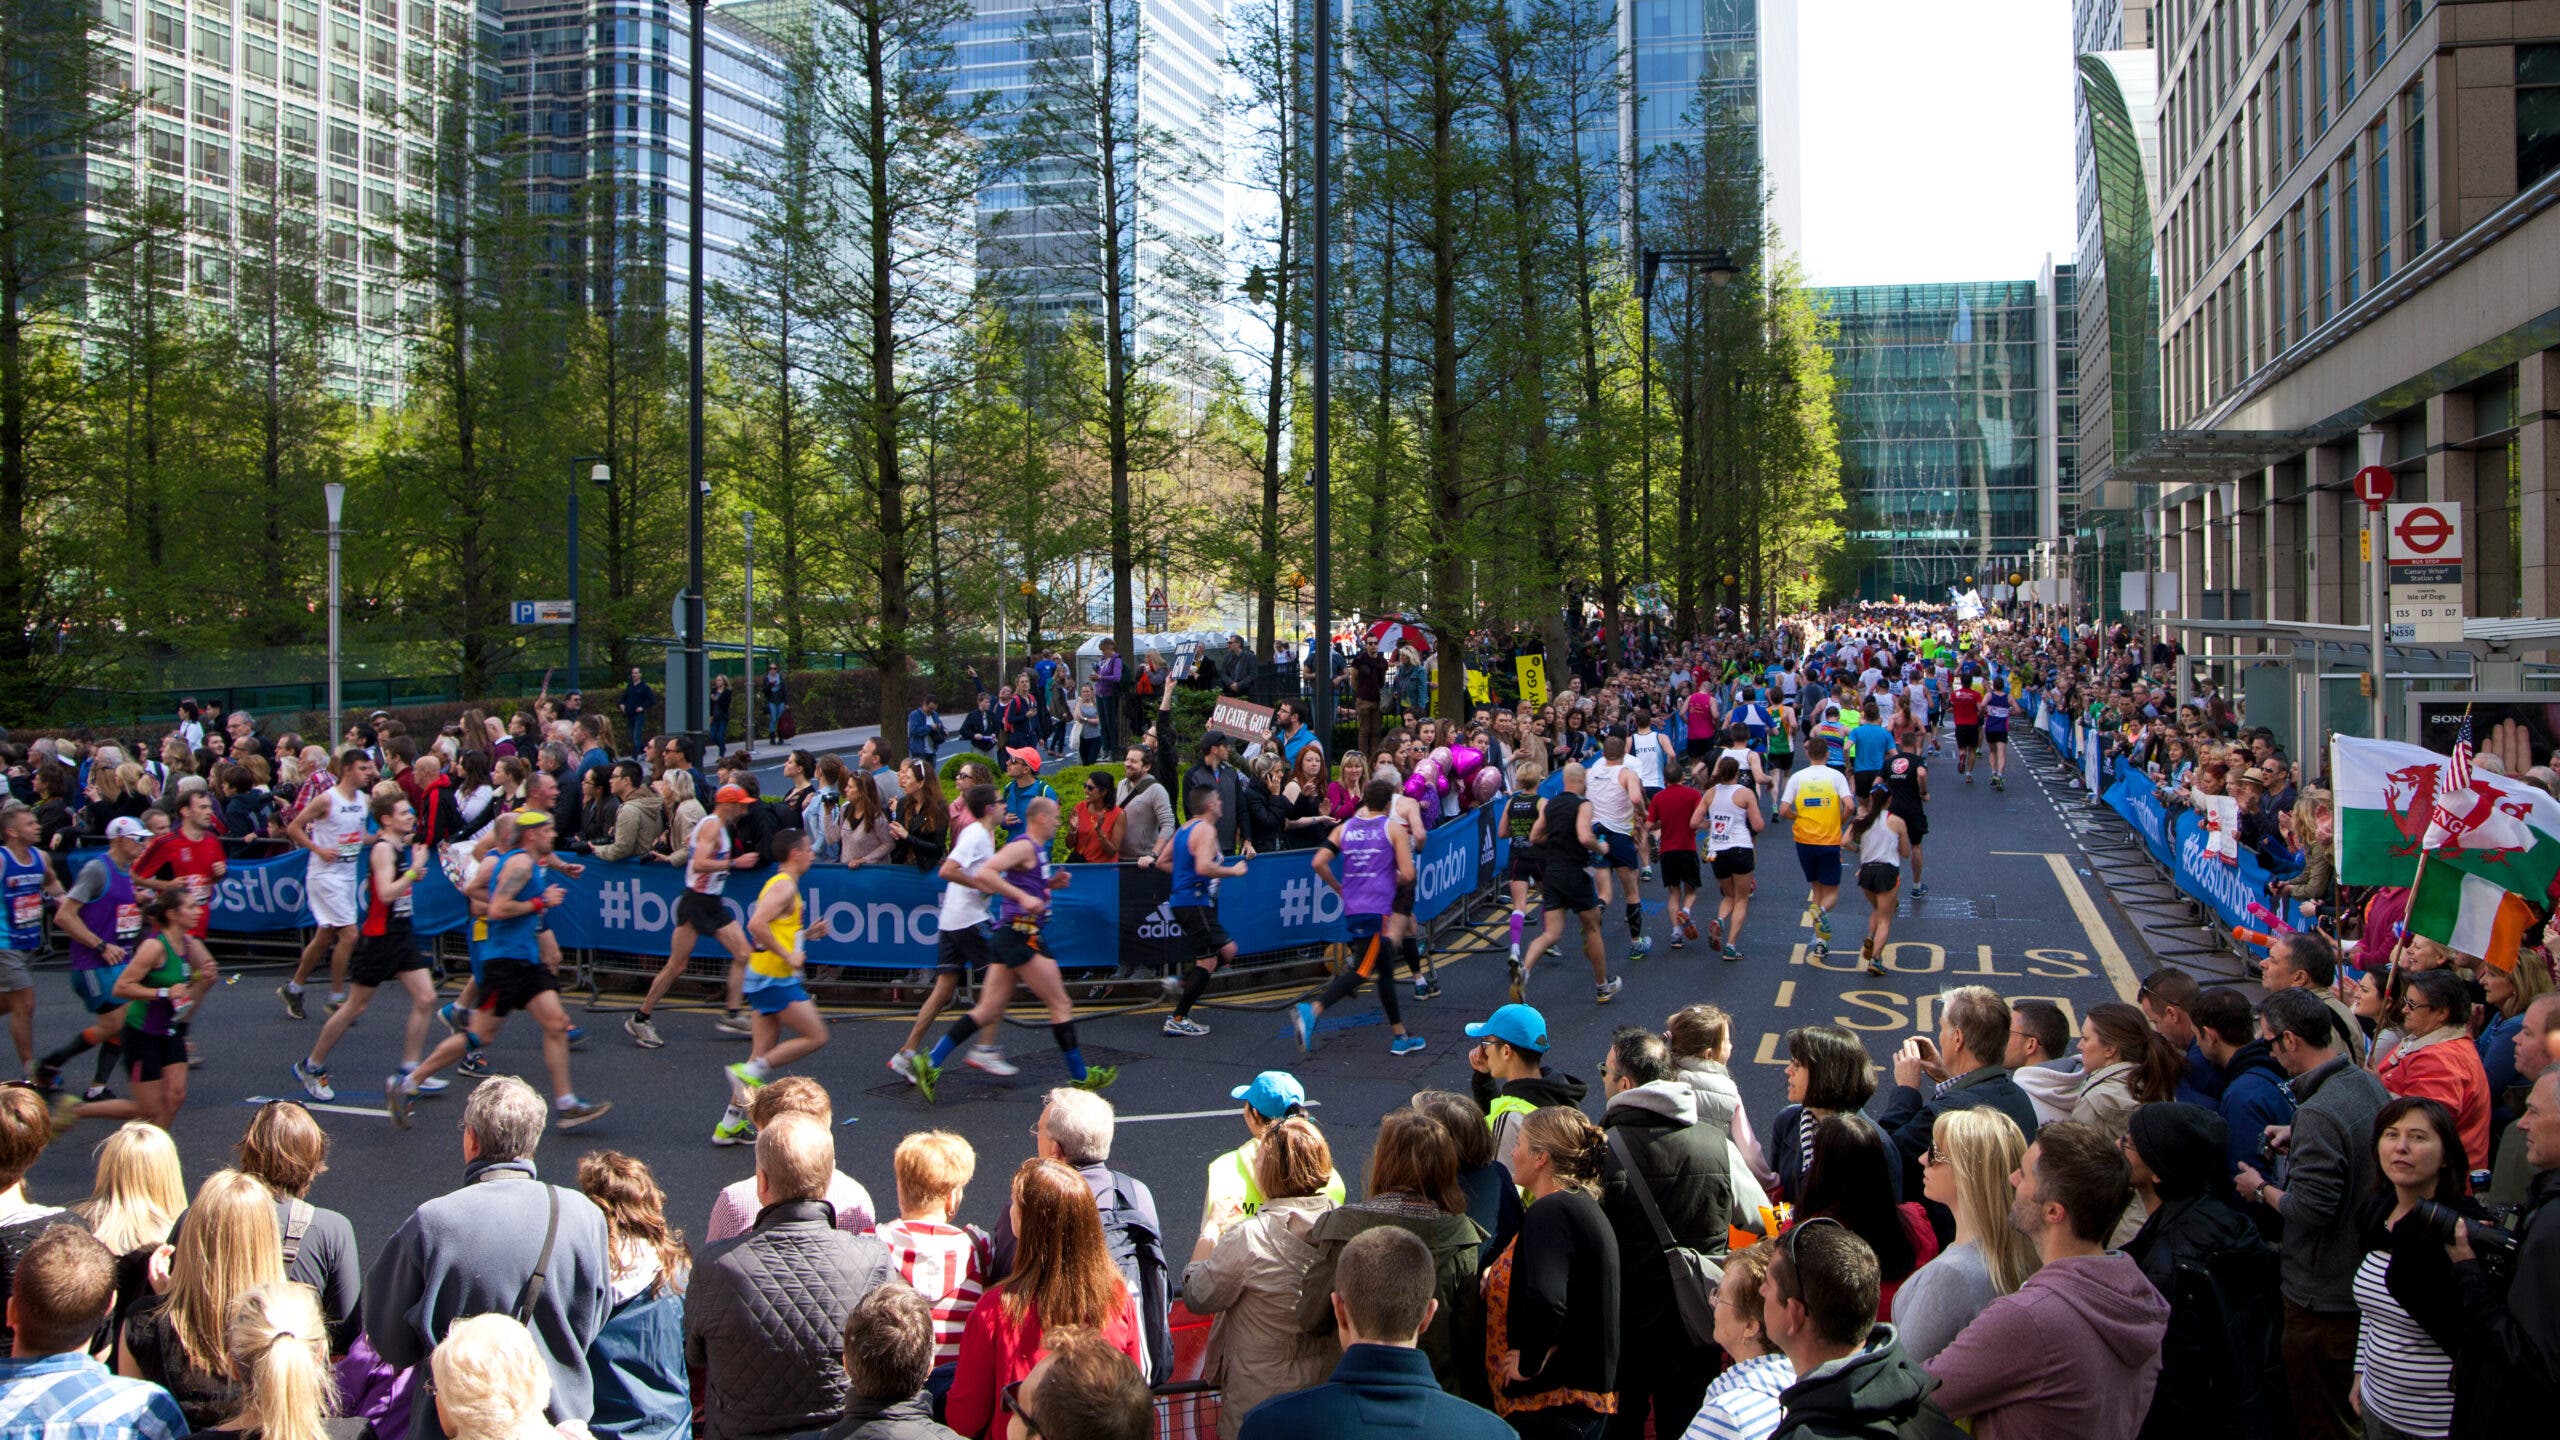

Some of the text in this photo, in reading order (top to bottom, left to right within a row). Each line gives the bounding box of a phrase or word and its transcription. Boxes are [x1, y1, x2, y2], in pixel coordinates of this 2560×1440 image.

[2365, 472, 2383, 500] L
[2404, 567, 2449, 576] Canary Wharf
[2429, 593, 2446, 601] Dogs
[2421, 609, 2433, 617] D3
[2445, 608, 2457, 617] D7
[2391, 629, 2415, 637] N550
[1526, 669, 1537, 688] GO
[1213, 704, 1226, 722] GO
